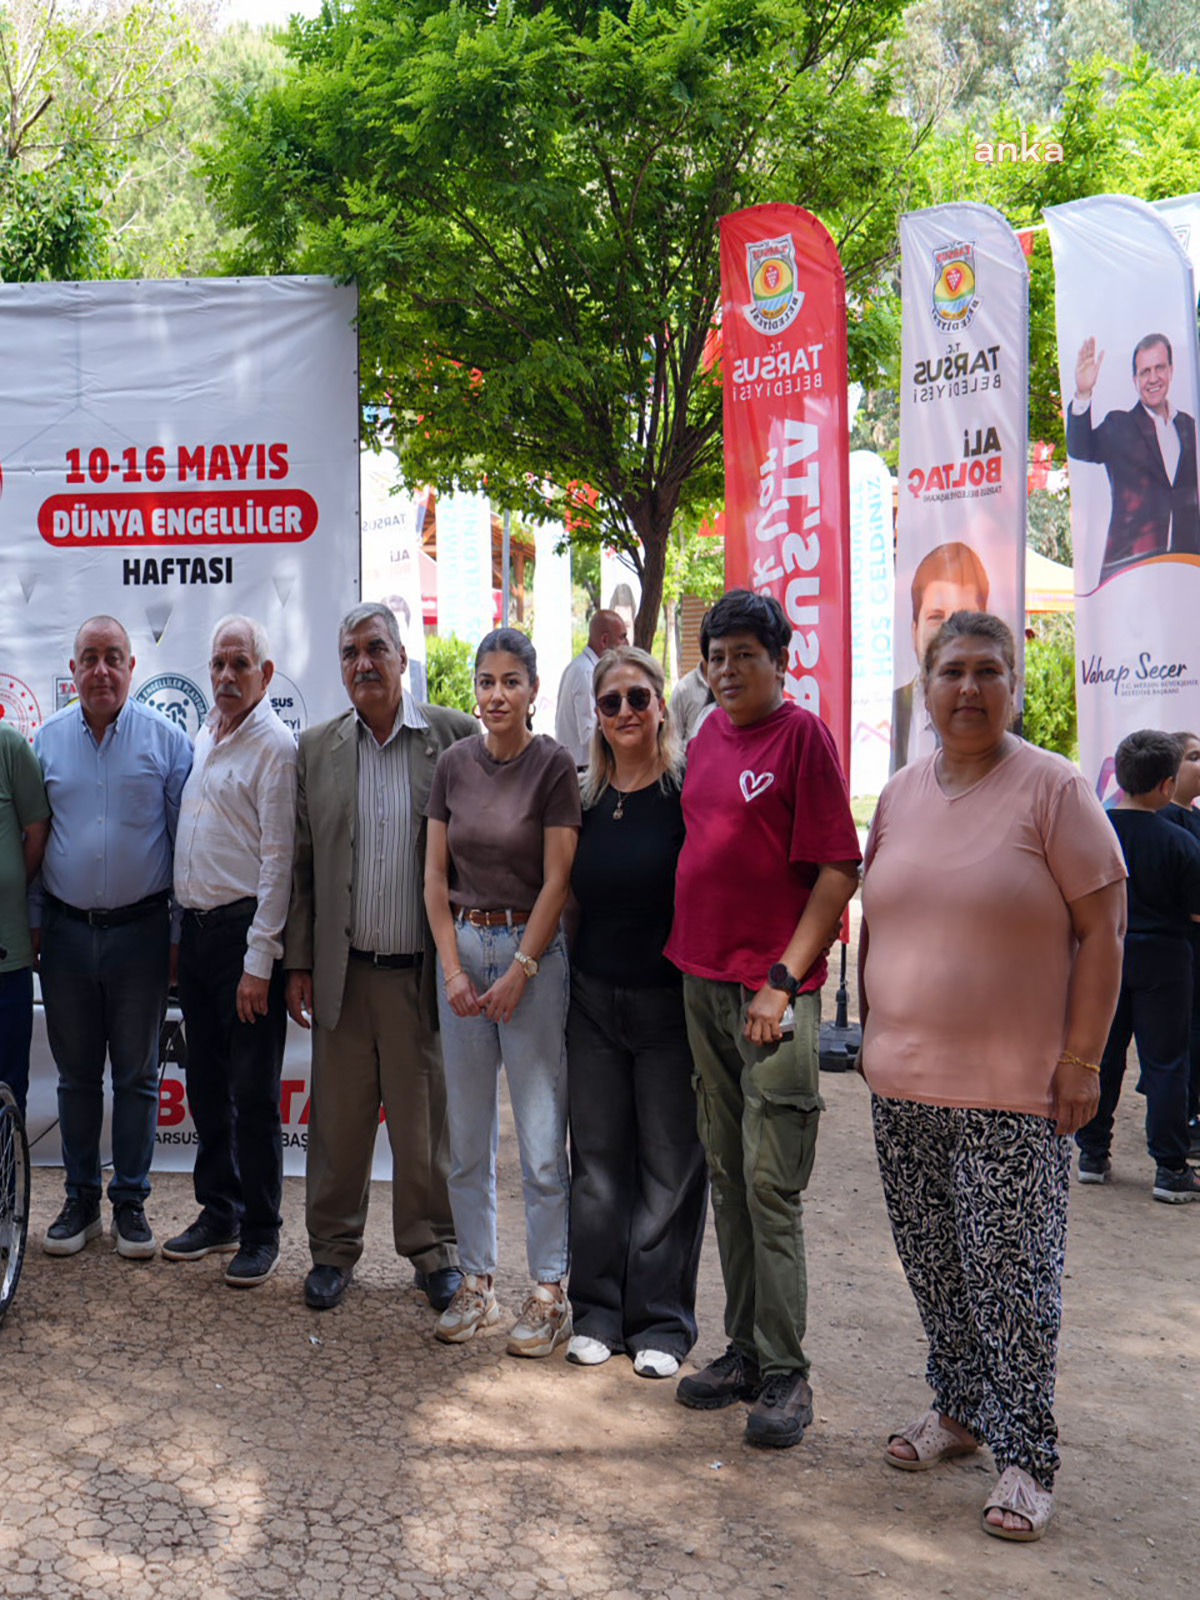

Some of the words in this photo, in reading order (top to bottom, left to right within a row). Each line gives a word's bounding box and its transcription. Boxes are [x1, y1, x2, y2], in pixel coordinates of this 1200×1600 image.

[65, 446, 166, 484] 10-16
[177, 443, 289, 482] MAYIS
[52, 503, 145, 539] DÜNYA
[151, 499, 303, 536] ENGELLİLER
[122, 556, 233, 585] HAFTASI
[154, 1131, 200, 1145] ARSUS
